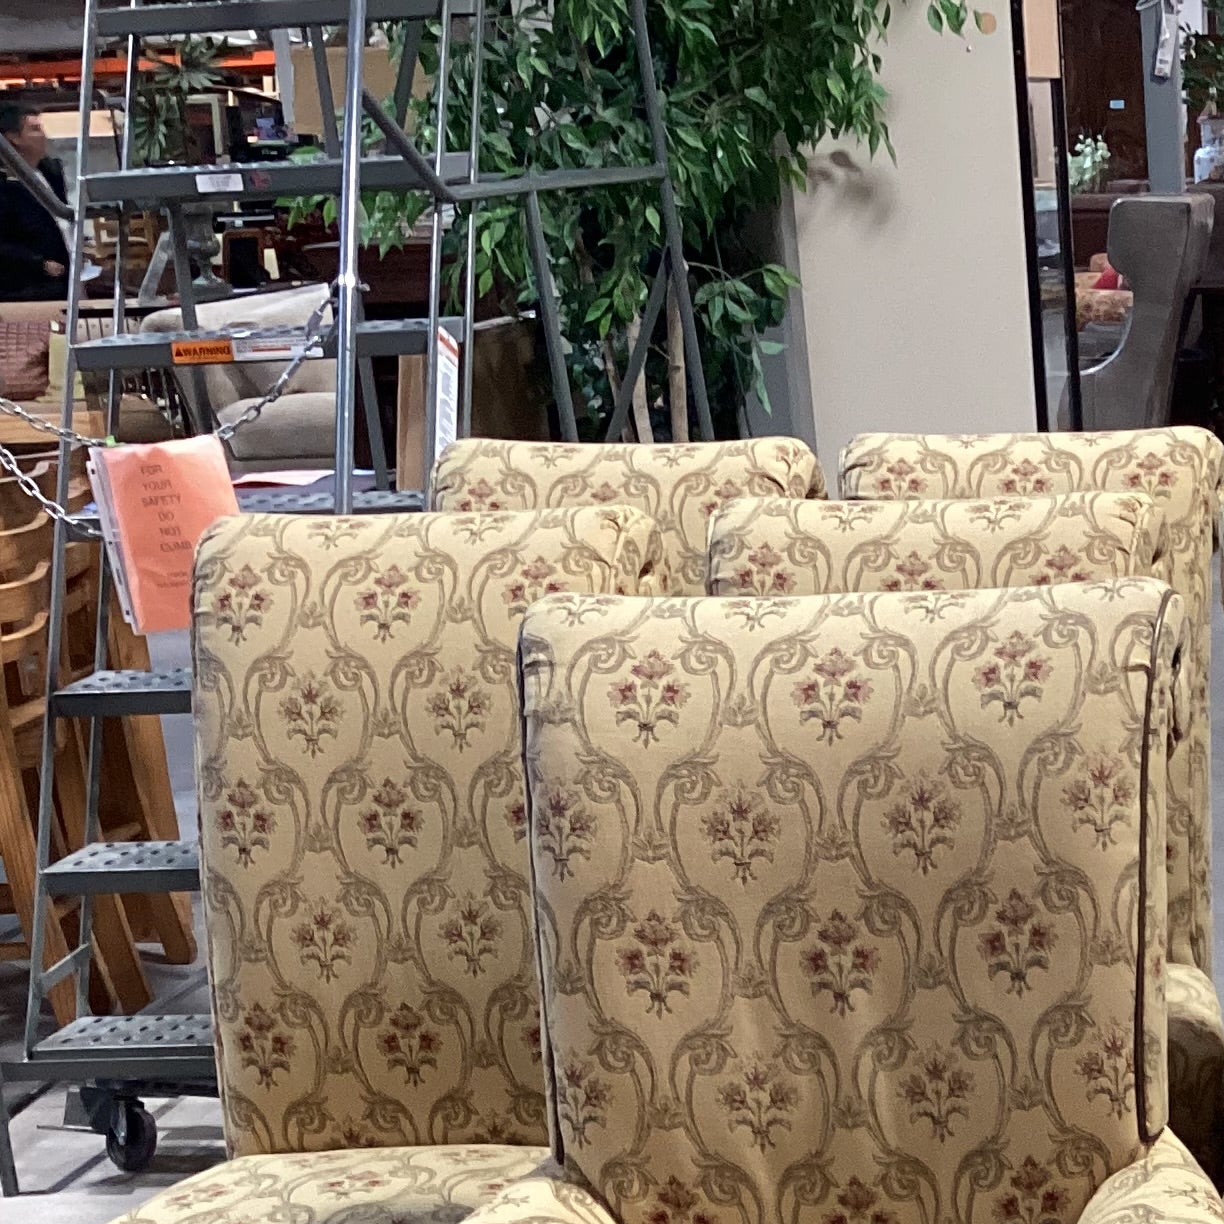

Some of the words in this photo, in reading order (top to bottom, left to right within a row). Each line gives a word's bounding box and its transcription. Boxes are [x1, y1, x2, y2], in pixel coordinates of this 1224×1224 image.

[183, 345, 230, 357] WARNING
[140, 464, 163, 475] FOR
[143, 479, 171, 491] YOUR
[143, 494, 181, 508] SAFETY
[158, 511, 174, 522] DO
[160, 526, 181, 536] NOT
[160, 541, 192, 552] CLIMB
